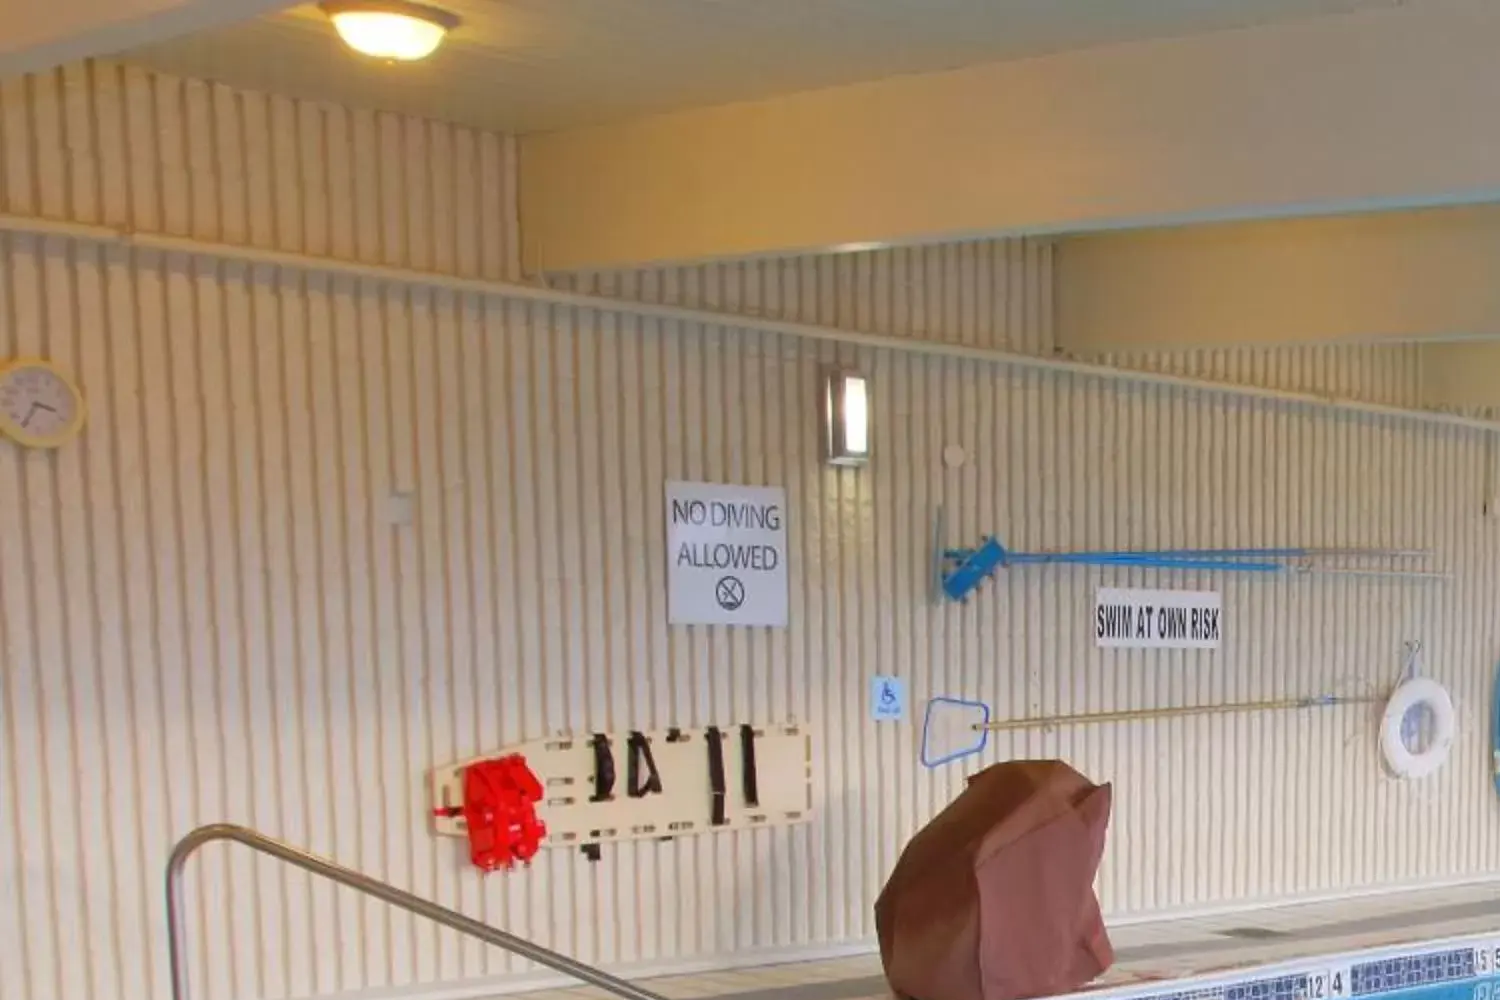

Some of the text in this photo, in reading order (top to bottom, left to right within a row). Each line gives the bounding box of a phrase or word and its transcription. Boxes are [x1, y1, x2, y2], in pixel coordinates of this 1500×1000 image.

[672, 498, 780, 531] NO DIVING
[677, 541, 778, 571] ALLOWED
[1097, 604, 1219, 640] SWIM AT OWN RISK
[1309, 971, 1342, 999] 12 4
